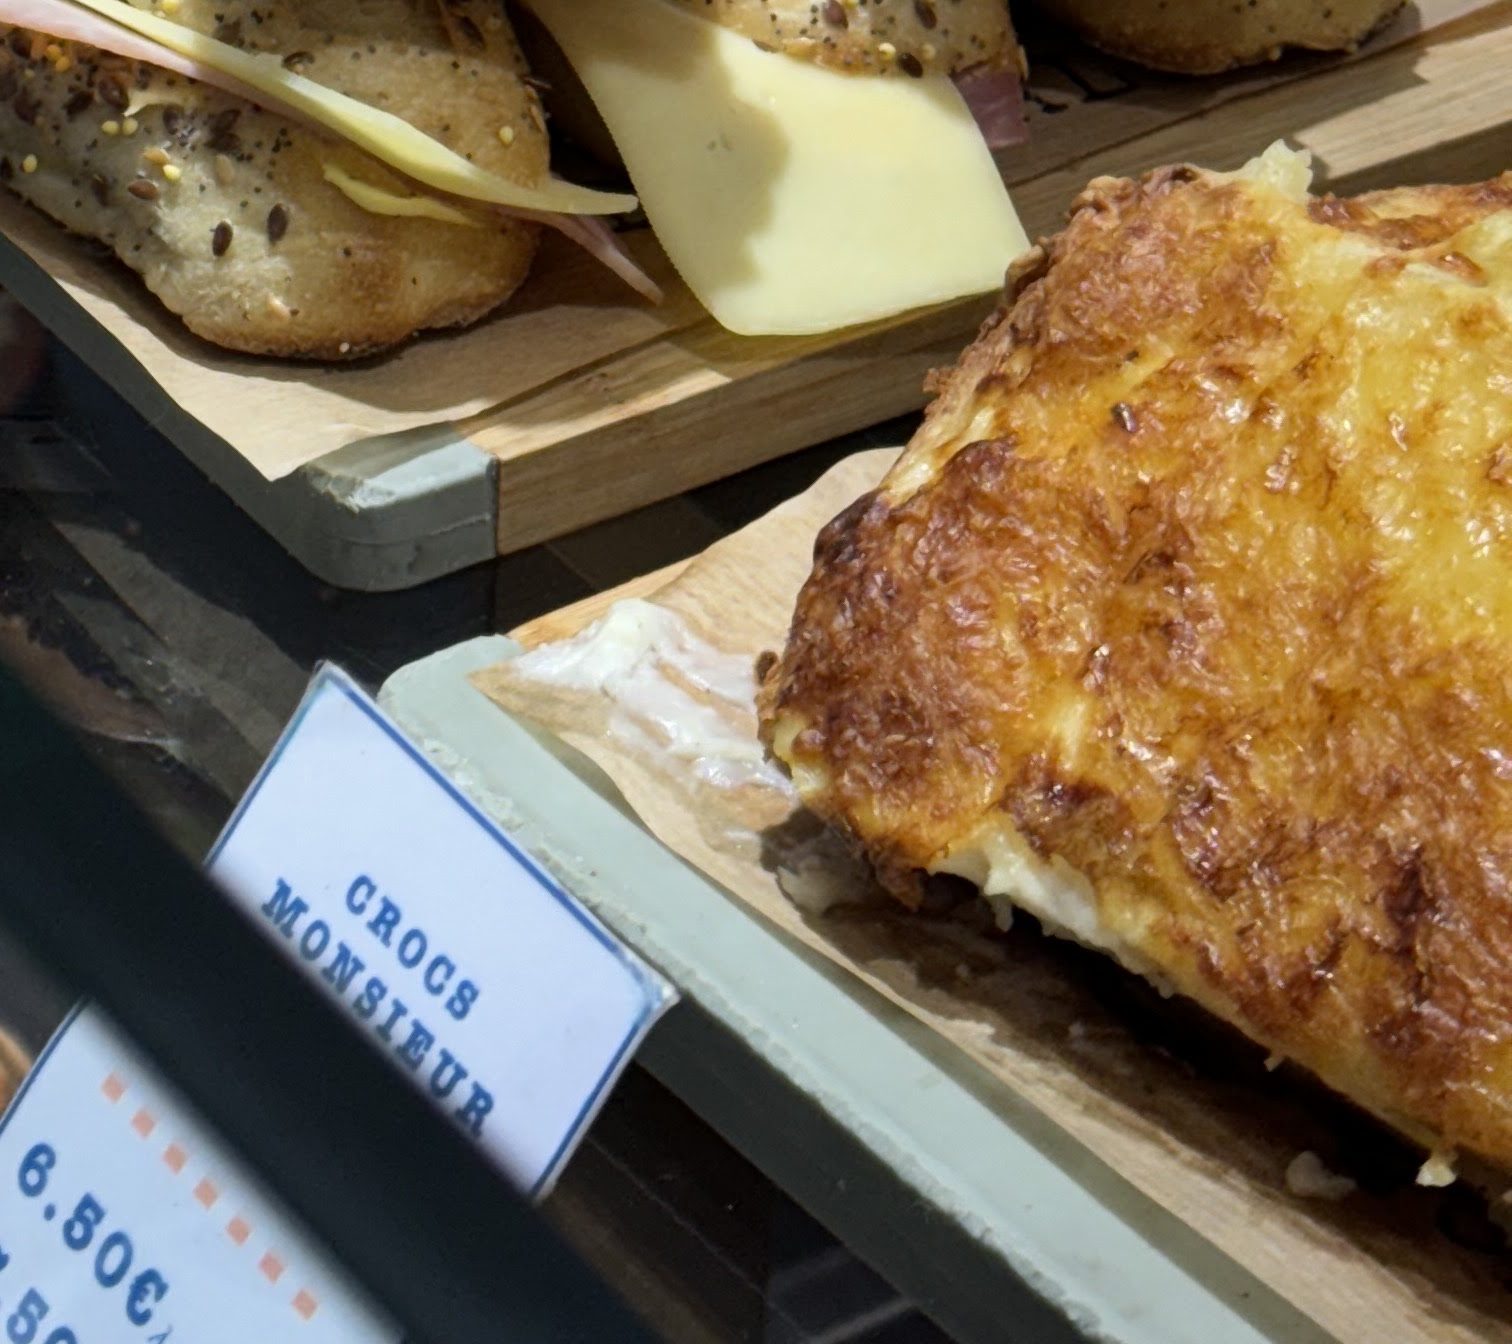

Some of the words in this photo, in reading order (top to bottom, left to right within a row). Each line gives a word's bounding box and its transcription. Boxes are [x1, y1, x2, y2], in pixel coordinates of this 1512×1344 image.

[261, 877, 494, 1137] MONSIEUR
[346, 875, 479, 1021] CROCS
[18, 1142, 168, 1326] 6.50€
